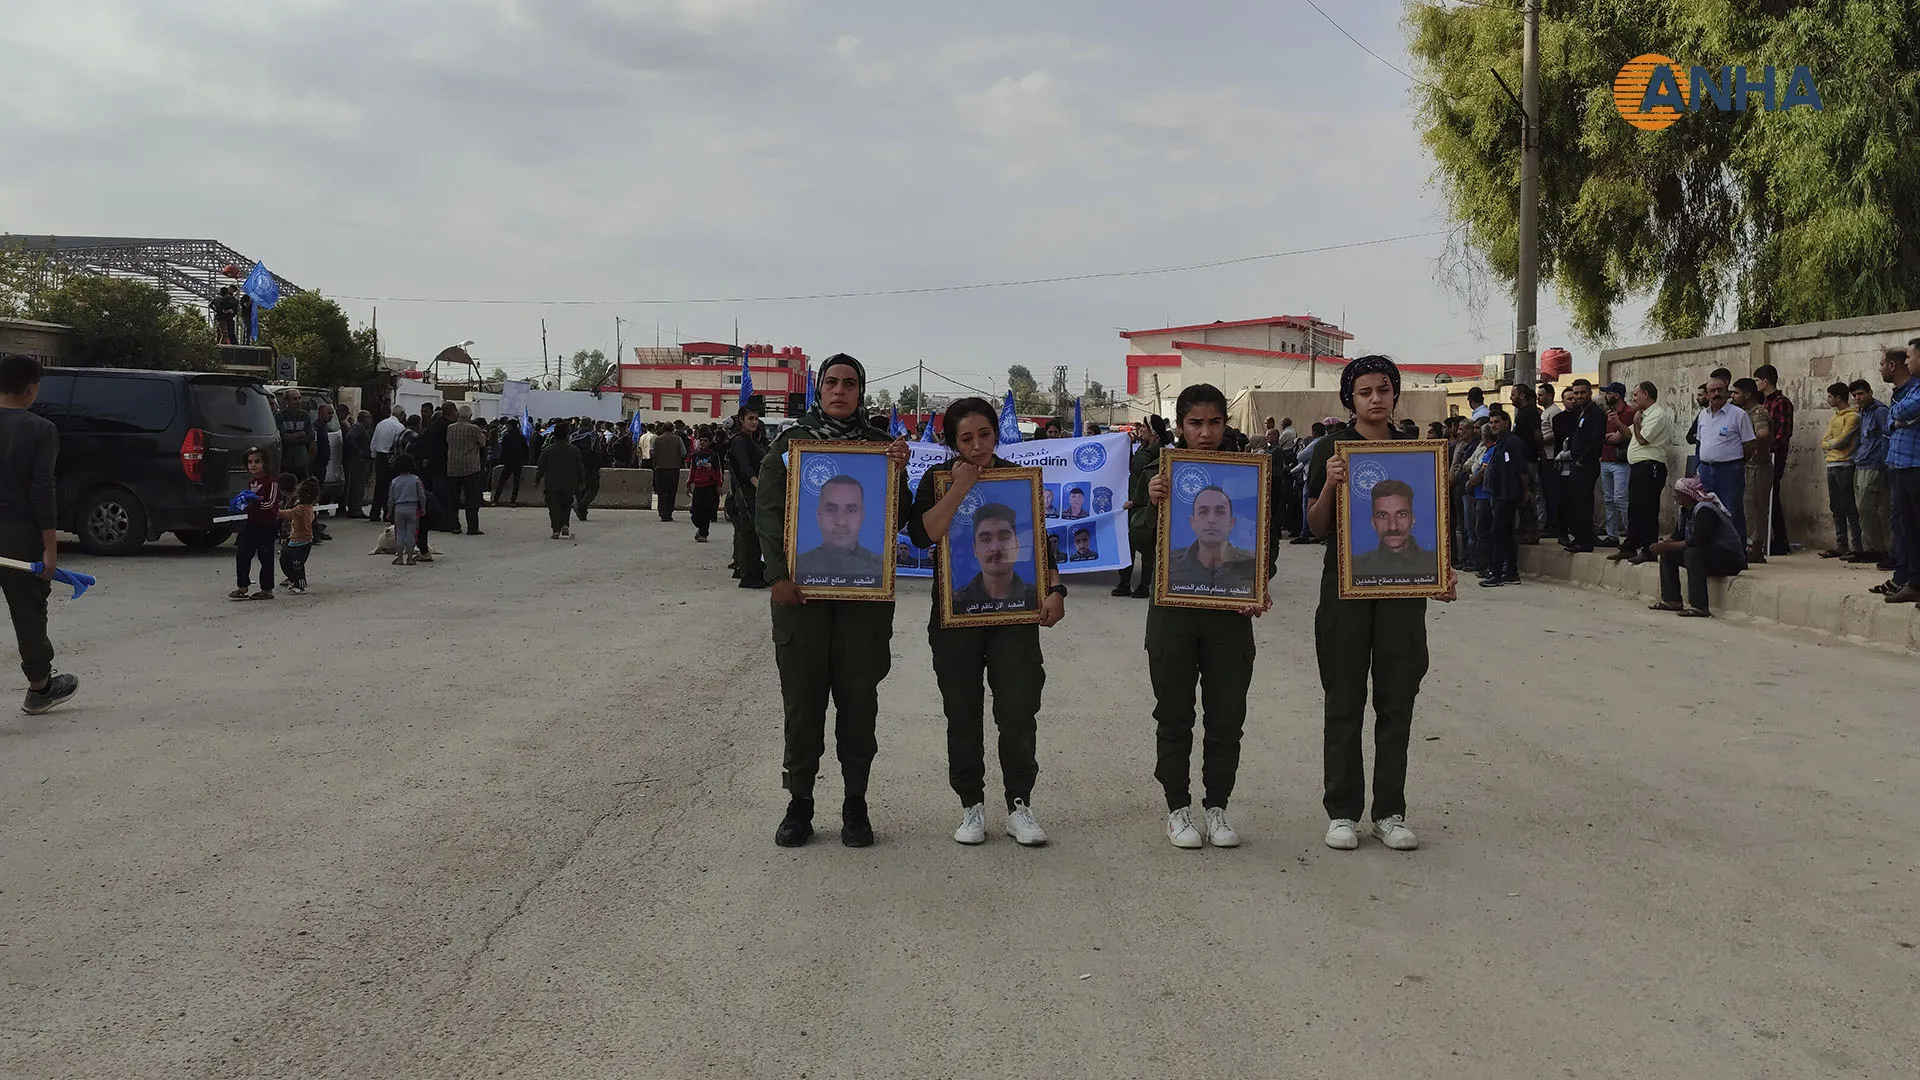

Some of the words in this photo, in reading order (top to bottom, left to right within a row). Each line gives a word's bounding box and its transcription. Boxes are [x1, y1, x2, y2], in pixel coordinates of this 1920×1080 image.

[831, 577, 846, 585] صالح
[853, 577, 875, 585] الشهيد
[1172, 583, 1195, 591] الحسين
[1210, 586, 1226, 594] بسام
[1229, 587, 1251, 595] الشهيد
